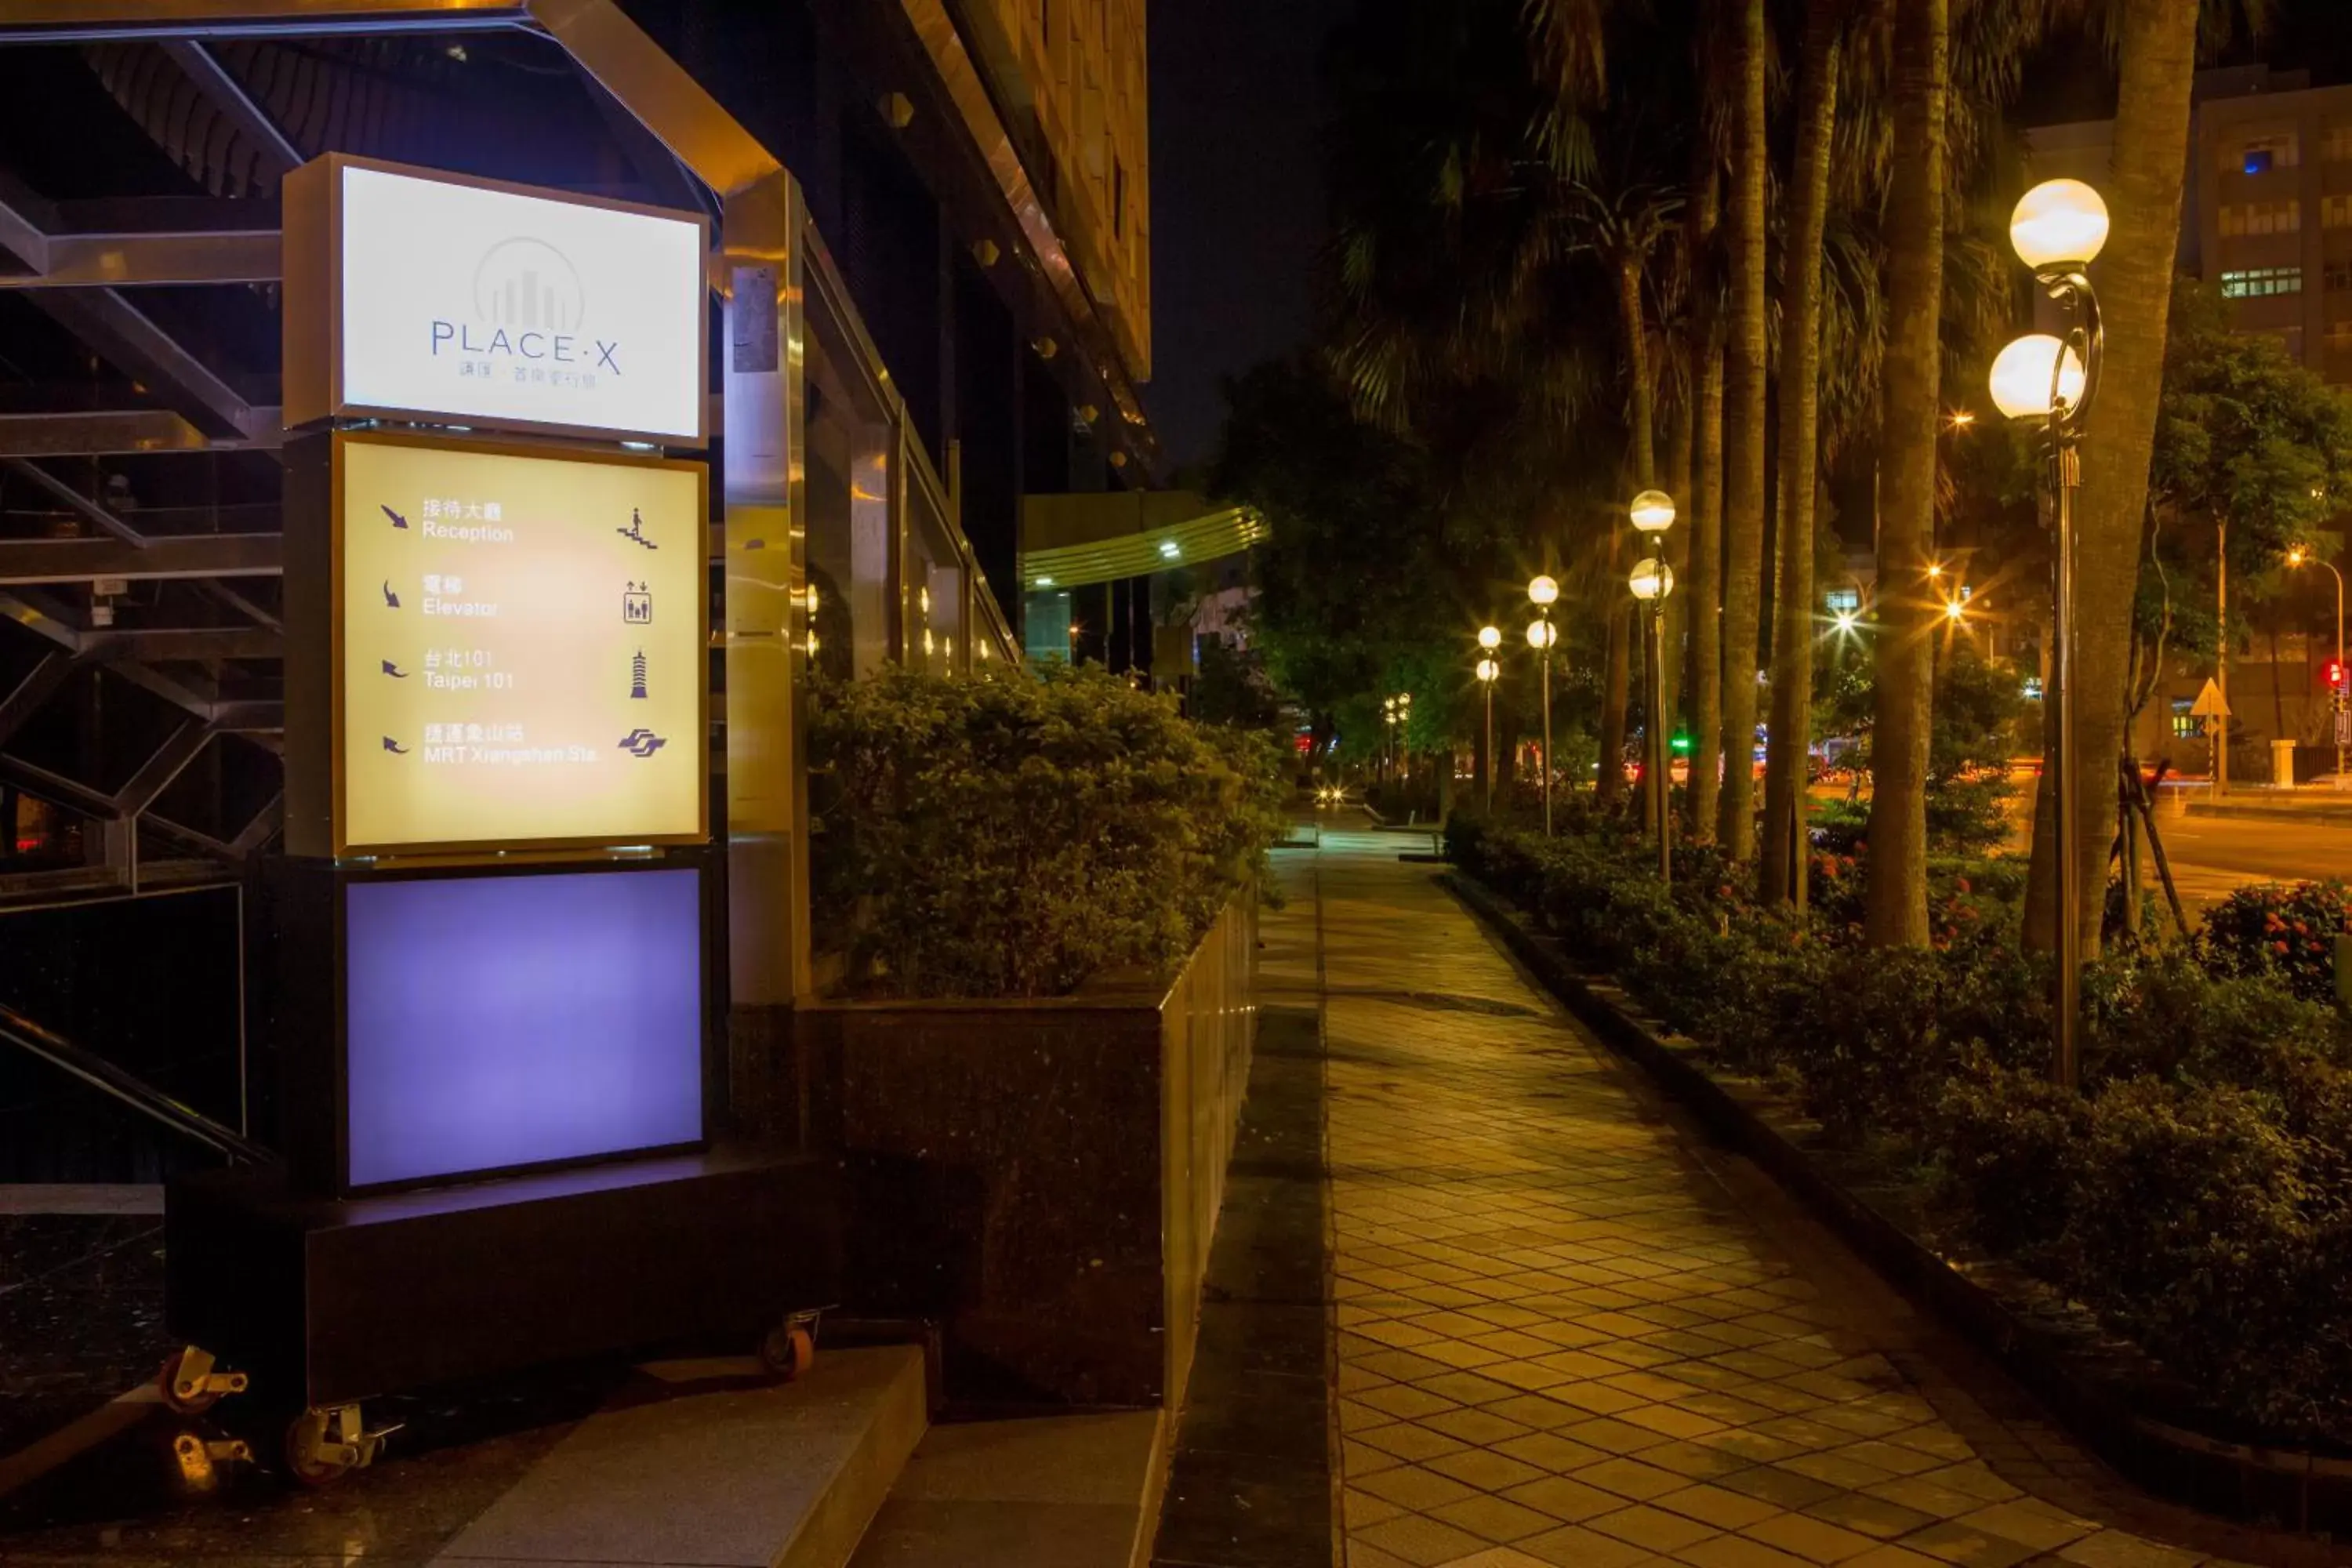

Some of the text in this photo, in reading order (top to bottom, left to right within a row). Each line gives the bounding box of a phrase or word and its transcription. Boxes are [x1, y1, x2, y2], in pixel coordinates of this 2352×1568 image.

[423, 521, 514, 542] Reception
[423, 598, 497, 616] Elevator
[424, 670, 513, 690] Taipei 101
[424, 747, 466, 764] MRT
